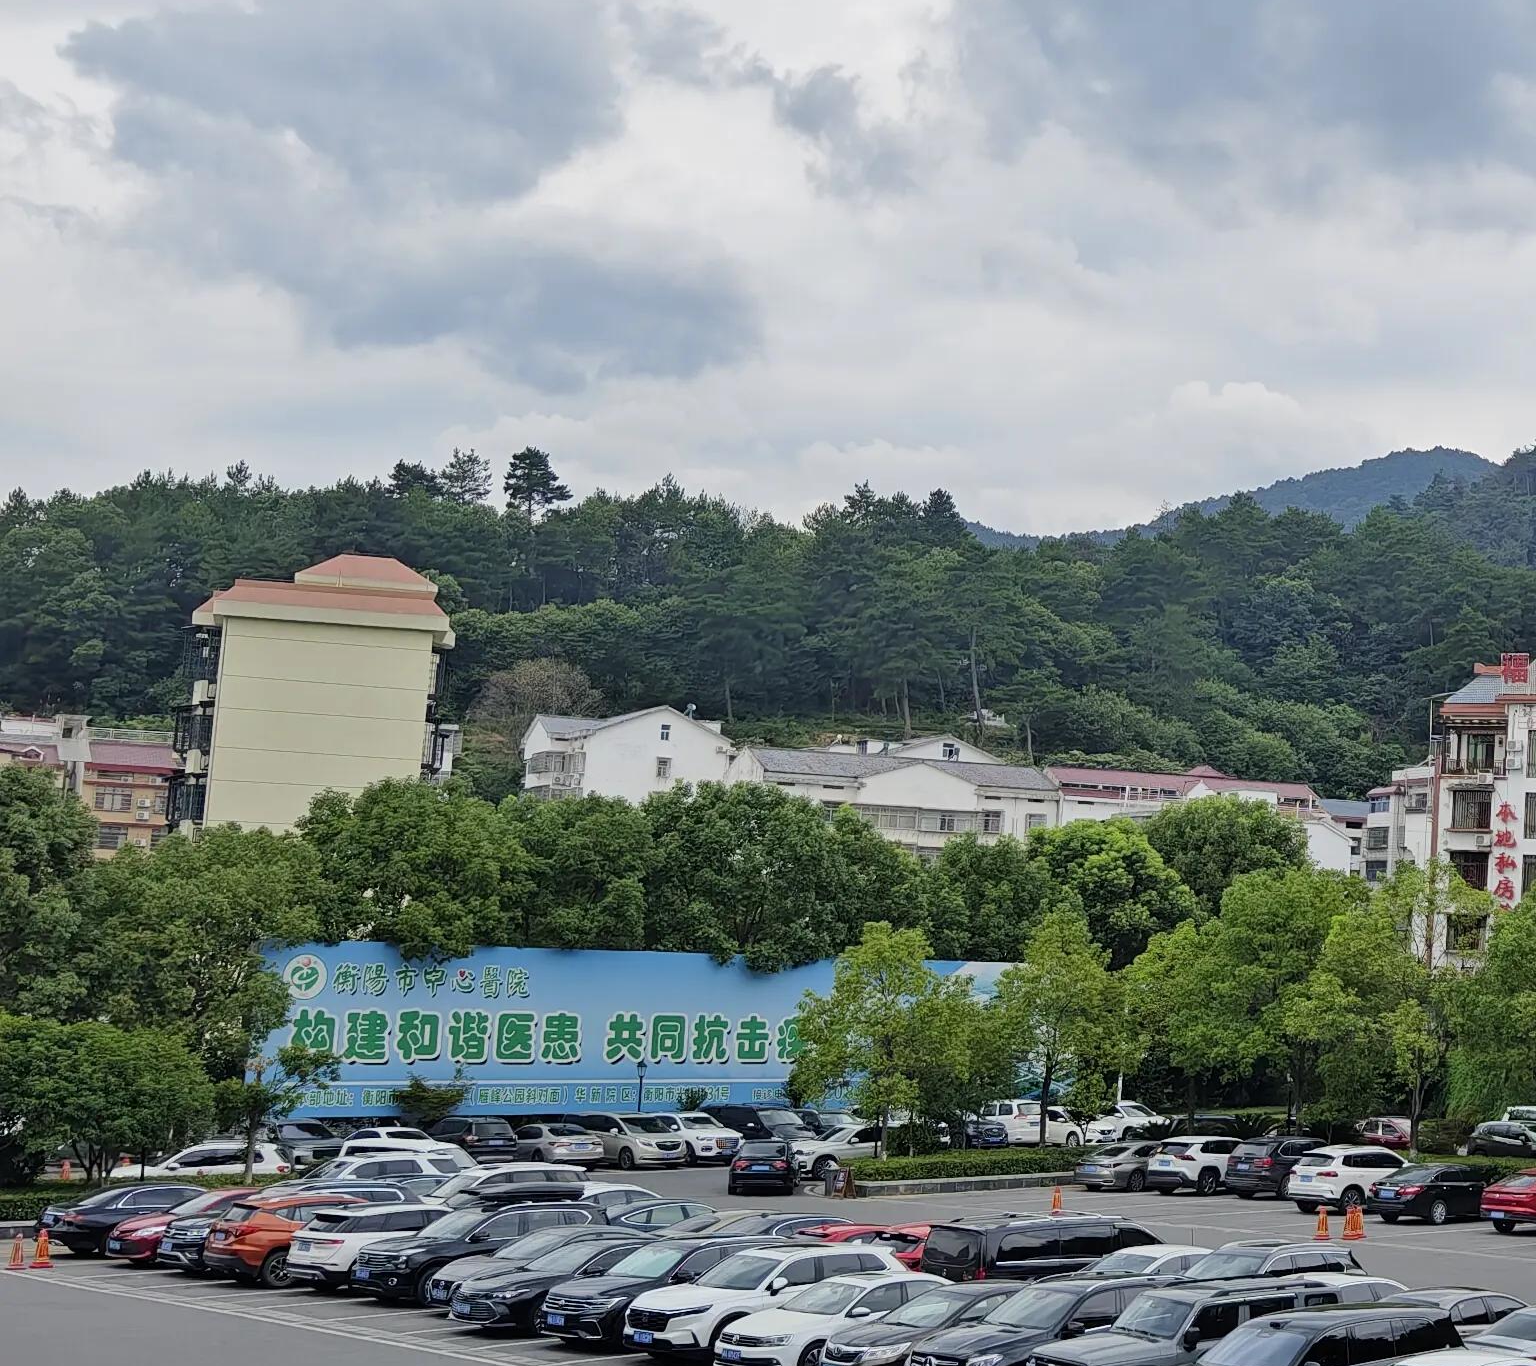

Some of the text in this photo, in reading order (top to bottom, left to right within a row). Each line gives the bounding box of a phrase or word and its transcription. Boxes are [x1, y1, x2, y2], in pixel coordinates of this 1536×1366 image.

[290, 1008, 582, 1065] 构建和谐医患
